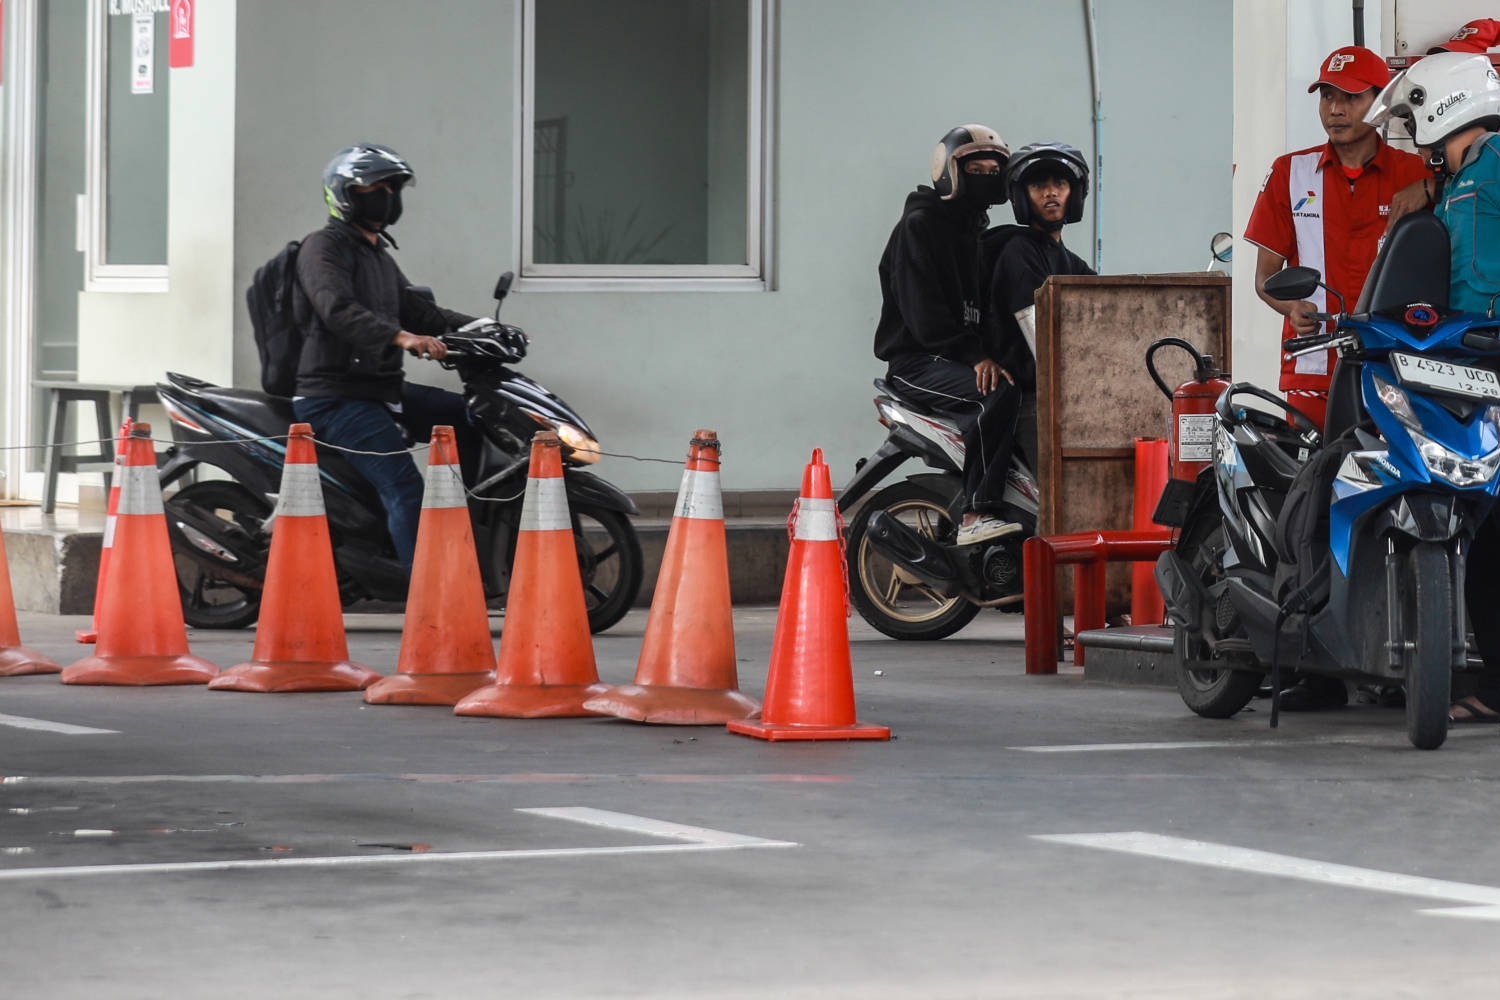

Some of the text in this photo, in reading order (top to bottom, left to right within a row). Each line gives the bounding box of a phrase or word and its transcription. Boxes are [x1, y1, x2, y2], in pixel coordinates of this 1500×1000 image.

[1399, 356, 1409, 366] B
[1417, 360, 1455, 376] 4523
[1376, 455, 1401, 478] HONDA
